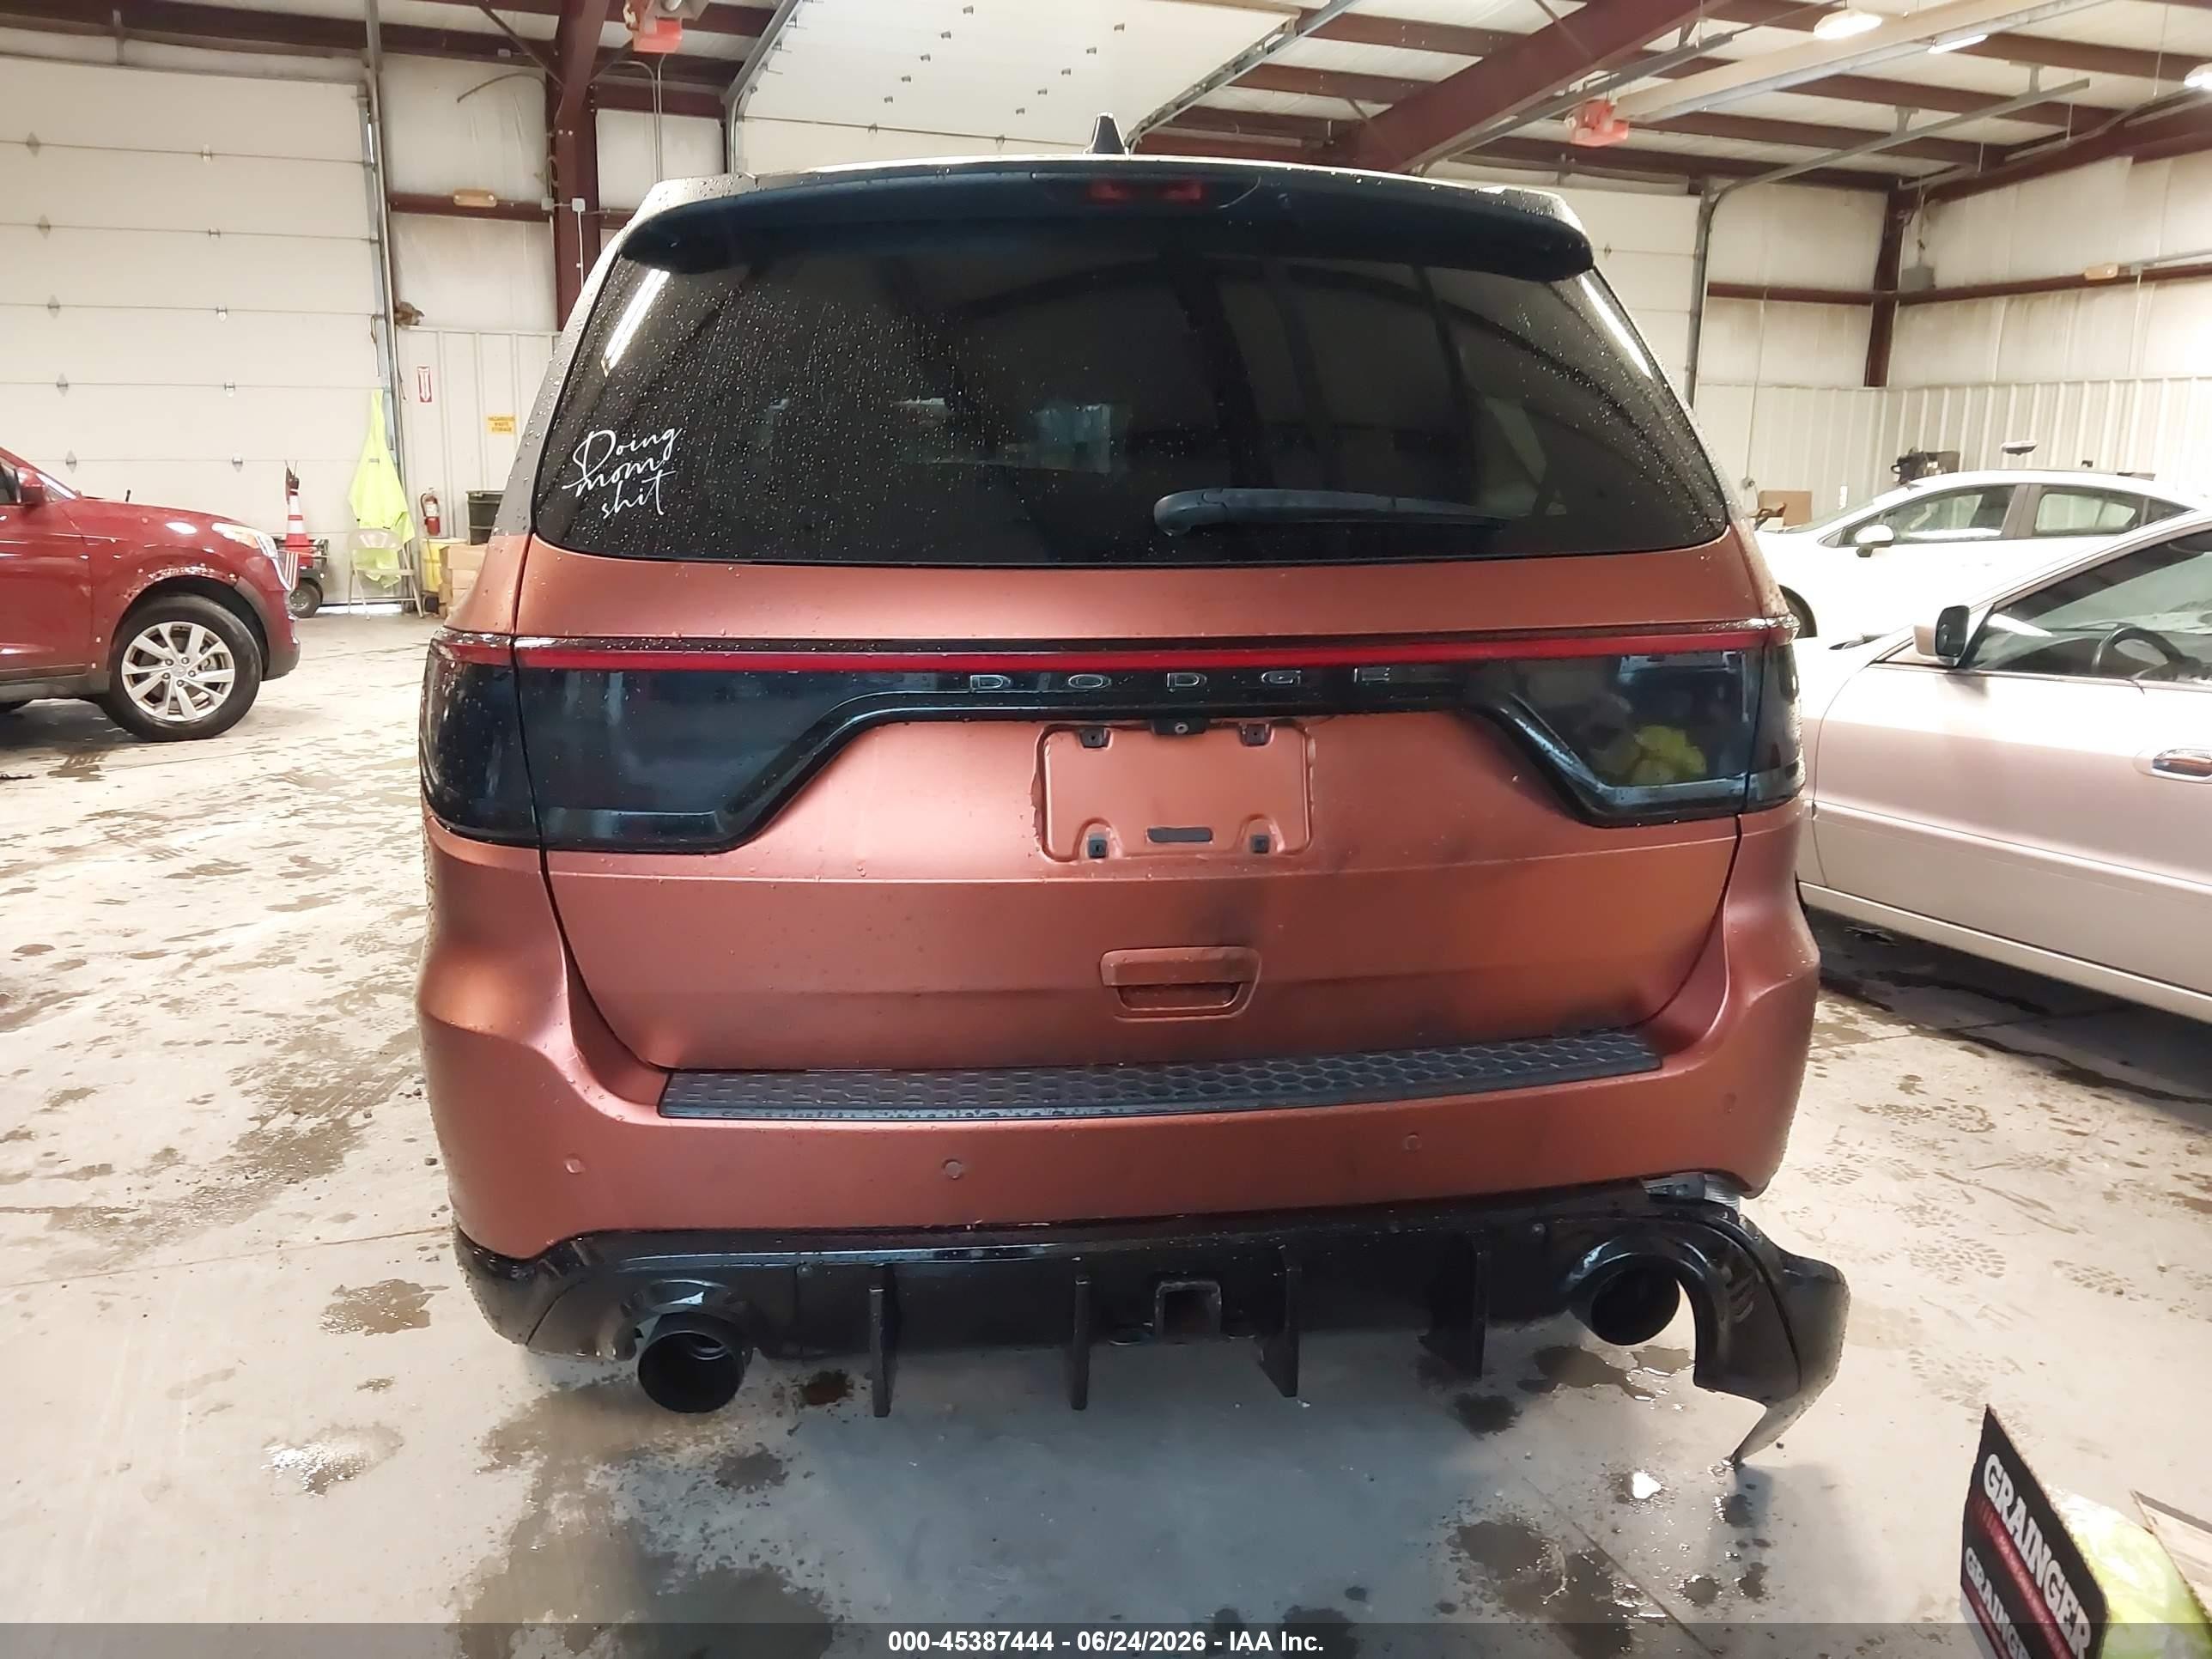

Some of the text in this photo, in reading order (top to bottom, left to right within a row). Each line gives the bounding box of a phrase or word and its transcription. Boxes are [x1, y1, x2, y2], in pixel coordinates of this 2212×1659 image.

[562, 457, 665, 497] mom
[573, 428, 683, 477] Doing
[602, 469, 677, 520] shit
[969, 666, 1391, 690] DODGE
[1984, 1454, 2092, 1659] GRAINGER
